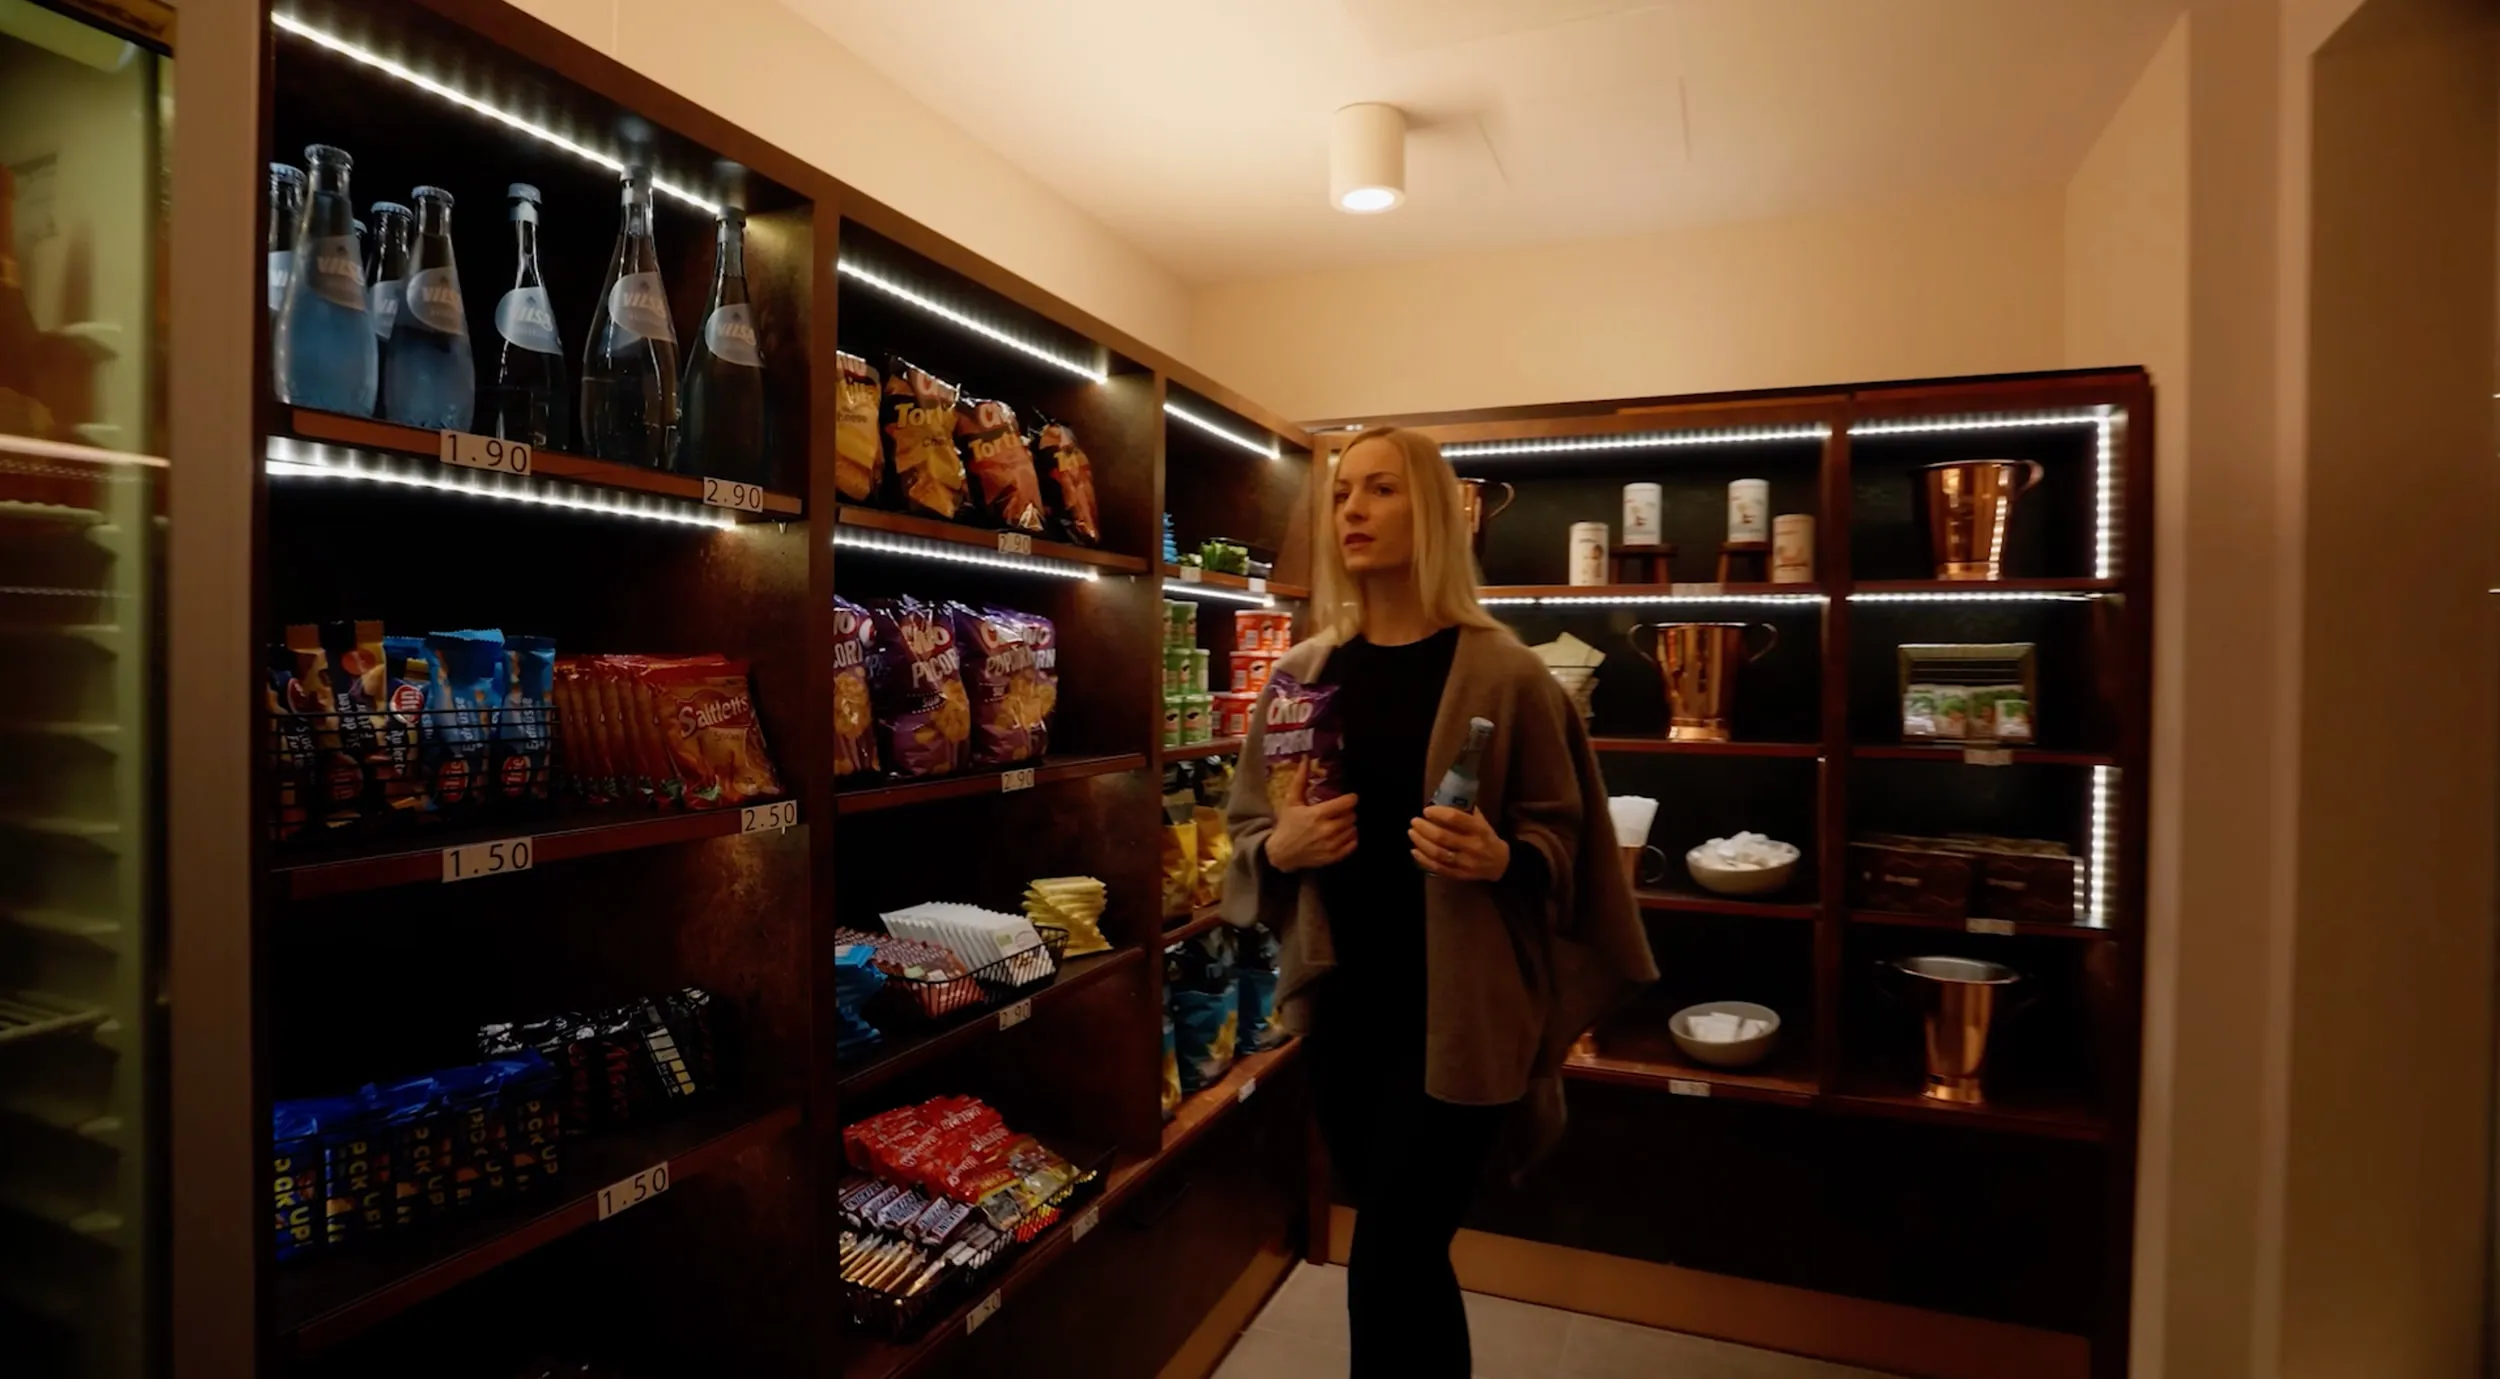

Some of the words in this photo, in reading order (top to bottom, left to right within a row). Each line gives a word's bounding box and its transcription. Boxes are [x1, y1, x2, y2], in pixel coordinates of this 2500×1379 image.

[447, 433, 527, 473] 1.90
[707, 478, 761, 509] 2.90
[679, 696, 750, 738] Saltletts
[1003, 769, 1032, 790] 290
[744, 802, 795, 831] 2.50
[450, 842, 528, 877] 1.50
[603, 1167, 666, 1214] 1.50
